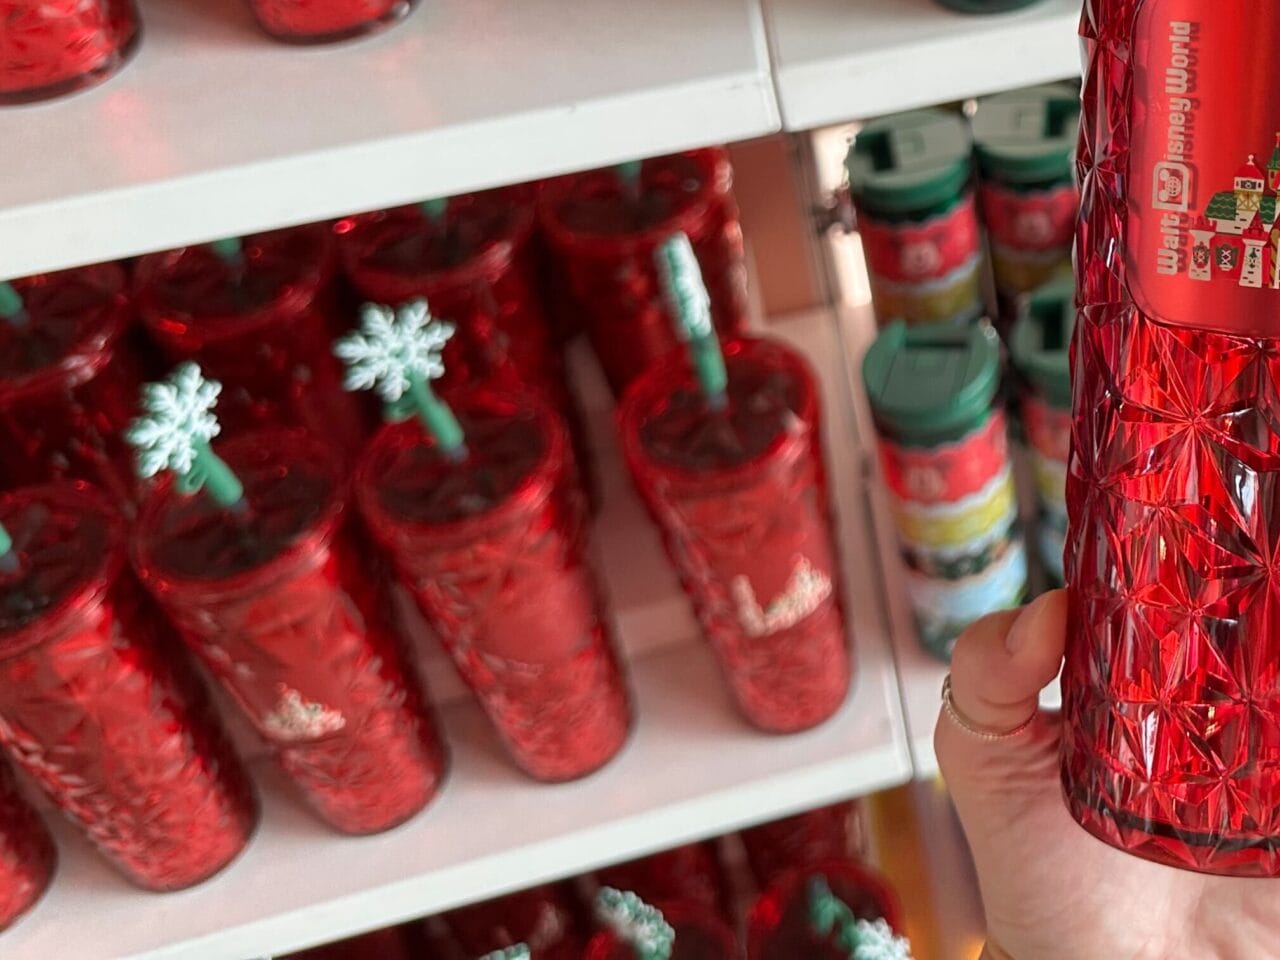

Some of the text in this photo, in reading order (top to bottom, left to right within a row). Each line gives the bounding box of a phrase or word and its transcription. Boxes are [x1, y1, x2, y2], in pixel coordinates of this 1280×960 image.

[1152, 21, 1192, 275] Walt Disney World
